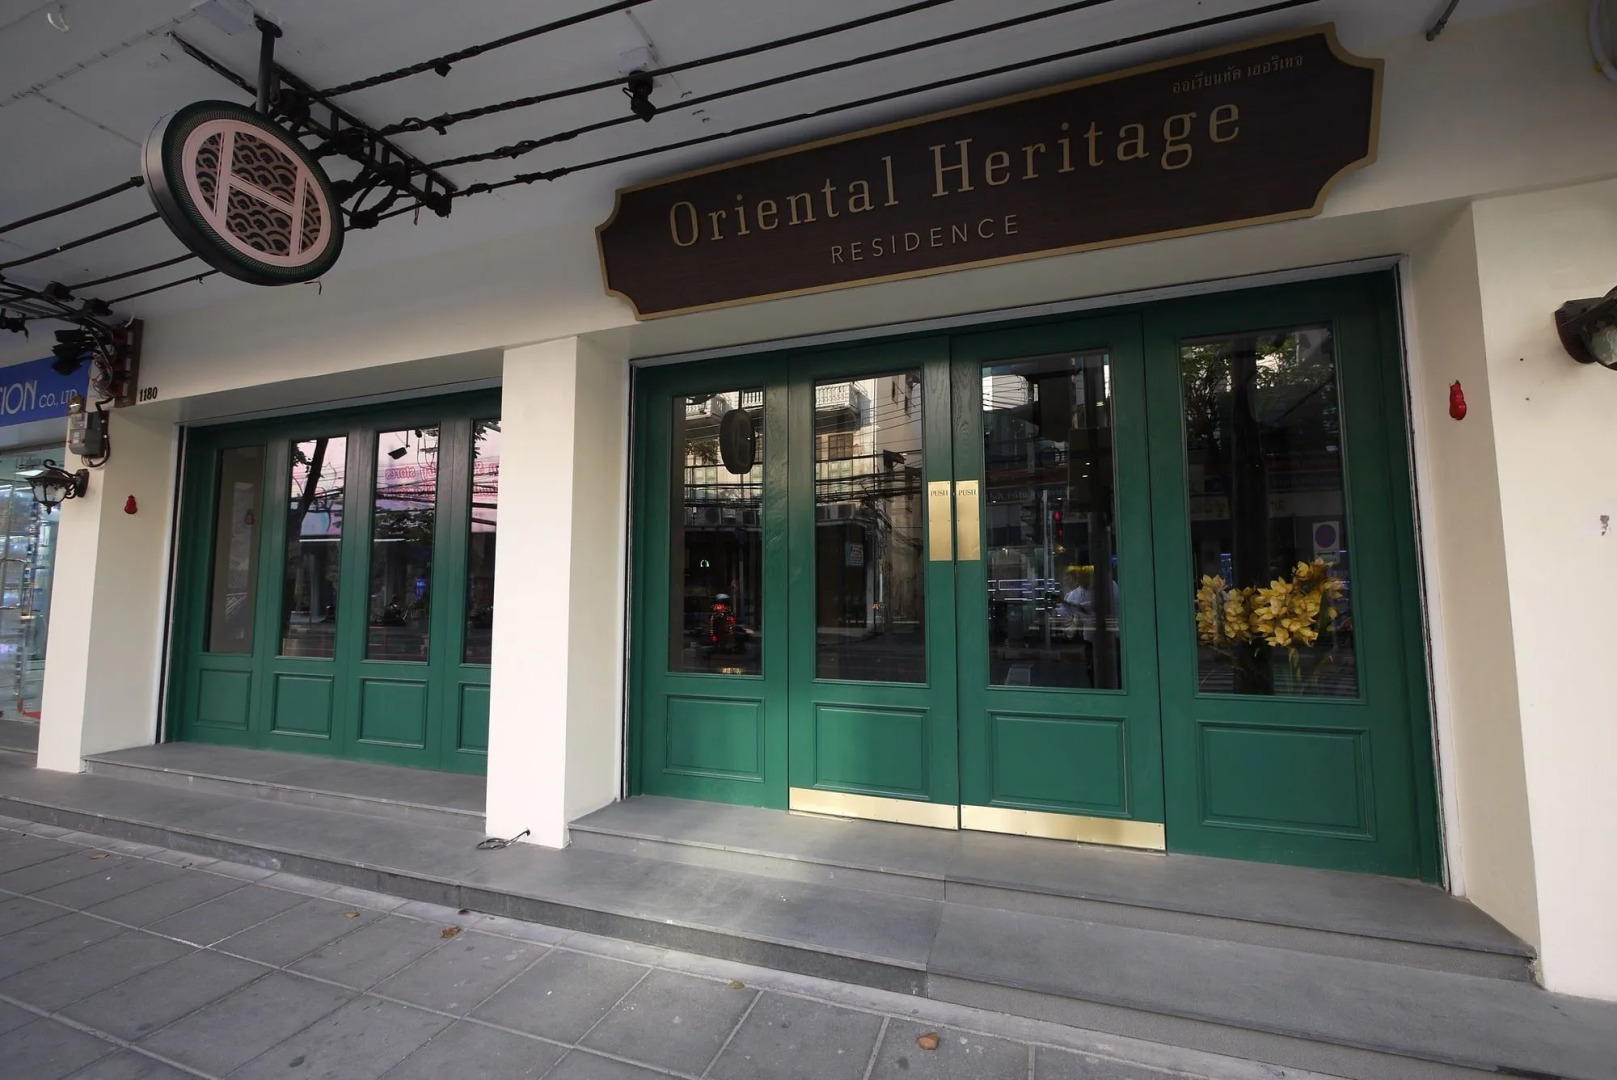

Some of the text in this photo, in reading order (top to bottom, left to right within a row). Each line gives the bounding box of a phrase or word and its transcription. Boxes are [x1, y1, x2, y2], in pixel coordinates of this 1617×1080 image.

[669, 101, 1240, 248] Oriental Heritage
[831, 214, 1020, 265] RESIDENCE
[139, 386, 158, 402] 1180
[930, 489, 948, 497] PUSH
